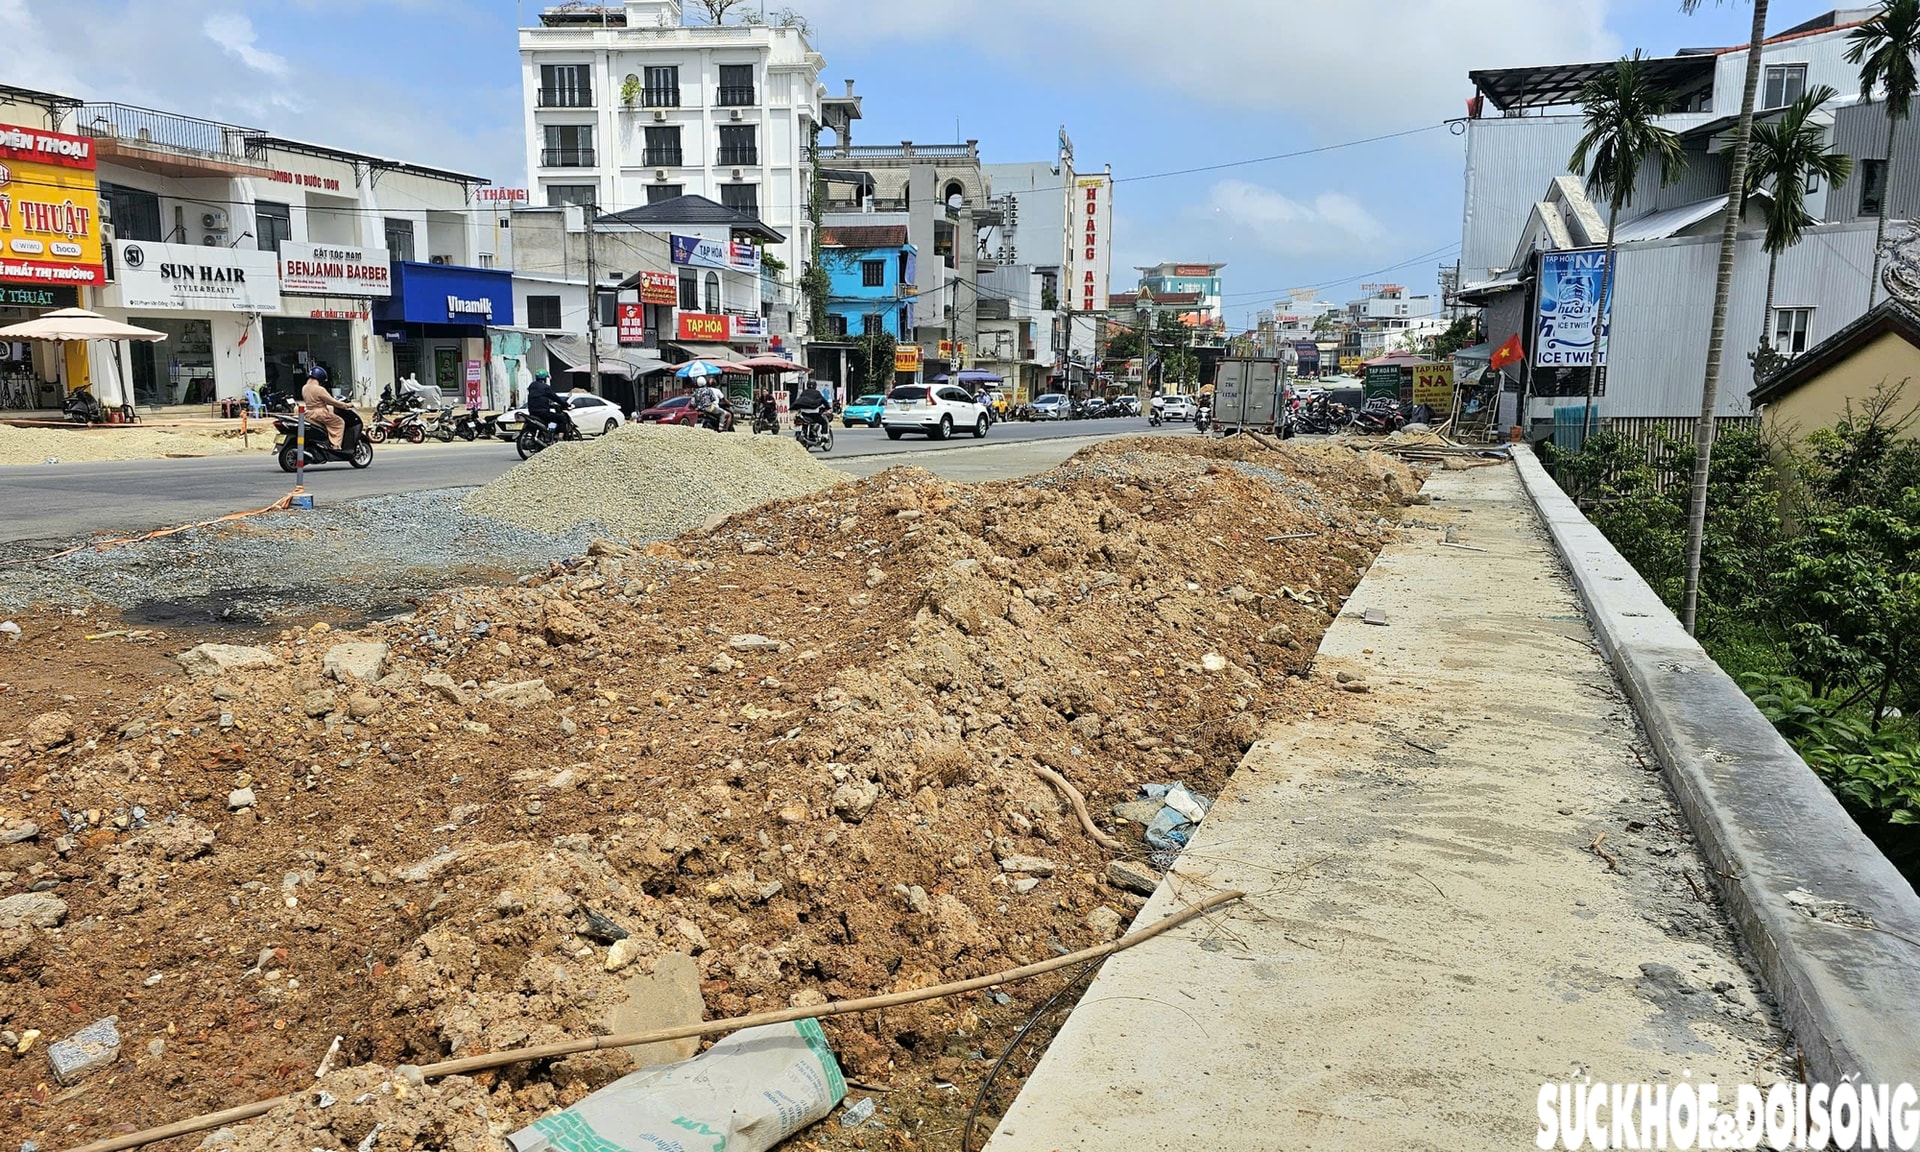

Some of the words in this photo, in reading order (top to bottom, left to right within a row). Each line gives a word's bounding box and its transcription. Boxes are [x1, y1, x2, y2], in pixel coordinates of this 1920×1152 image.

[36, 136, 89, 160] THOẠI
[268, 170, 293, 184] OMBO
[294, 174, 302, 185] 10
[323, 178, 340, 191] 100K
[19, 199, 90, 239] THUẬT
[1086, 188, 1097, 260] HOÀNG
[287, 260, 344, 279] BENJAMIN
[346, 264, 388, 281] BARBER
[1546, 255, 1559, 265] TẠP
[1560, 254, 1575, 263] HÓA
[1575, 253, 1612, 269] NA
[5, 262, 35, 277] NHẤT
[35, 266, 52, 281] THỊ
[53, 266, 95, 280] TRƯỜNG
[160, 263, 195, 280] SUN
[200, 266, 246, 283] HAIR
[8, 288, 54, 305] THUẬT
[173, 284, 199, 293] STYLE
[206, 286, 236, 295] BEAUTY
[1083, 271, 1095, 310] ANH
[447, 295, 493, 315] Vinamilk
[686, 319, 703, 336] TẠP
[704, 316, 723, 334] HÓA
[1538, 352, 1562, 364] ICE
[1415, 366, 1431, 375] TẠP
[1432, 364, 1452, 373] HÓA
[1419, 375, 1448, 388] NA
